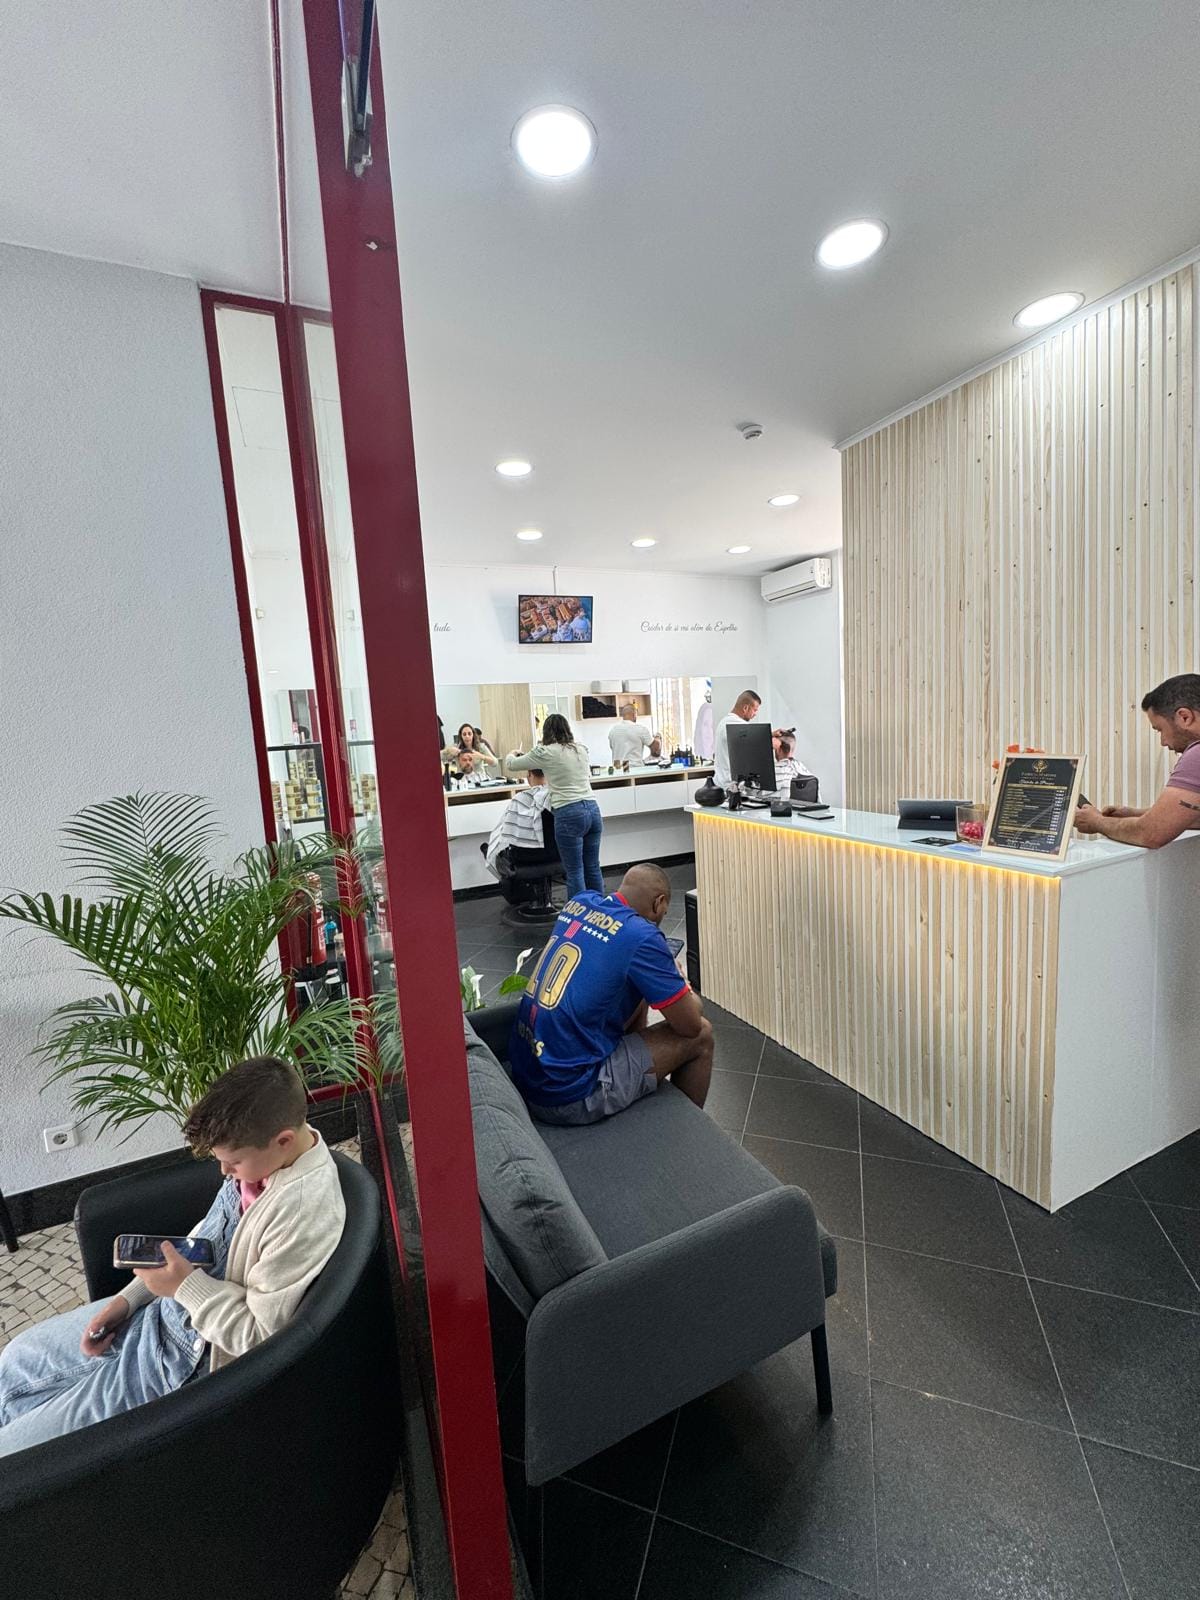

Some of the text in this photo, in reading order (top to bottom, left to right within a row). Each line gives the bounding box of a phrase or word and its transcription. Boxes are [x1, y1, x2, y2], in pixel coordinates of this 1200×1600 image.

[562, 900, 624, 936] CABO VERDE
[524, 934, 582, 1010] 10
